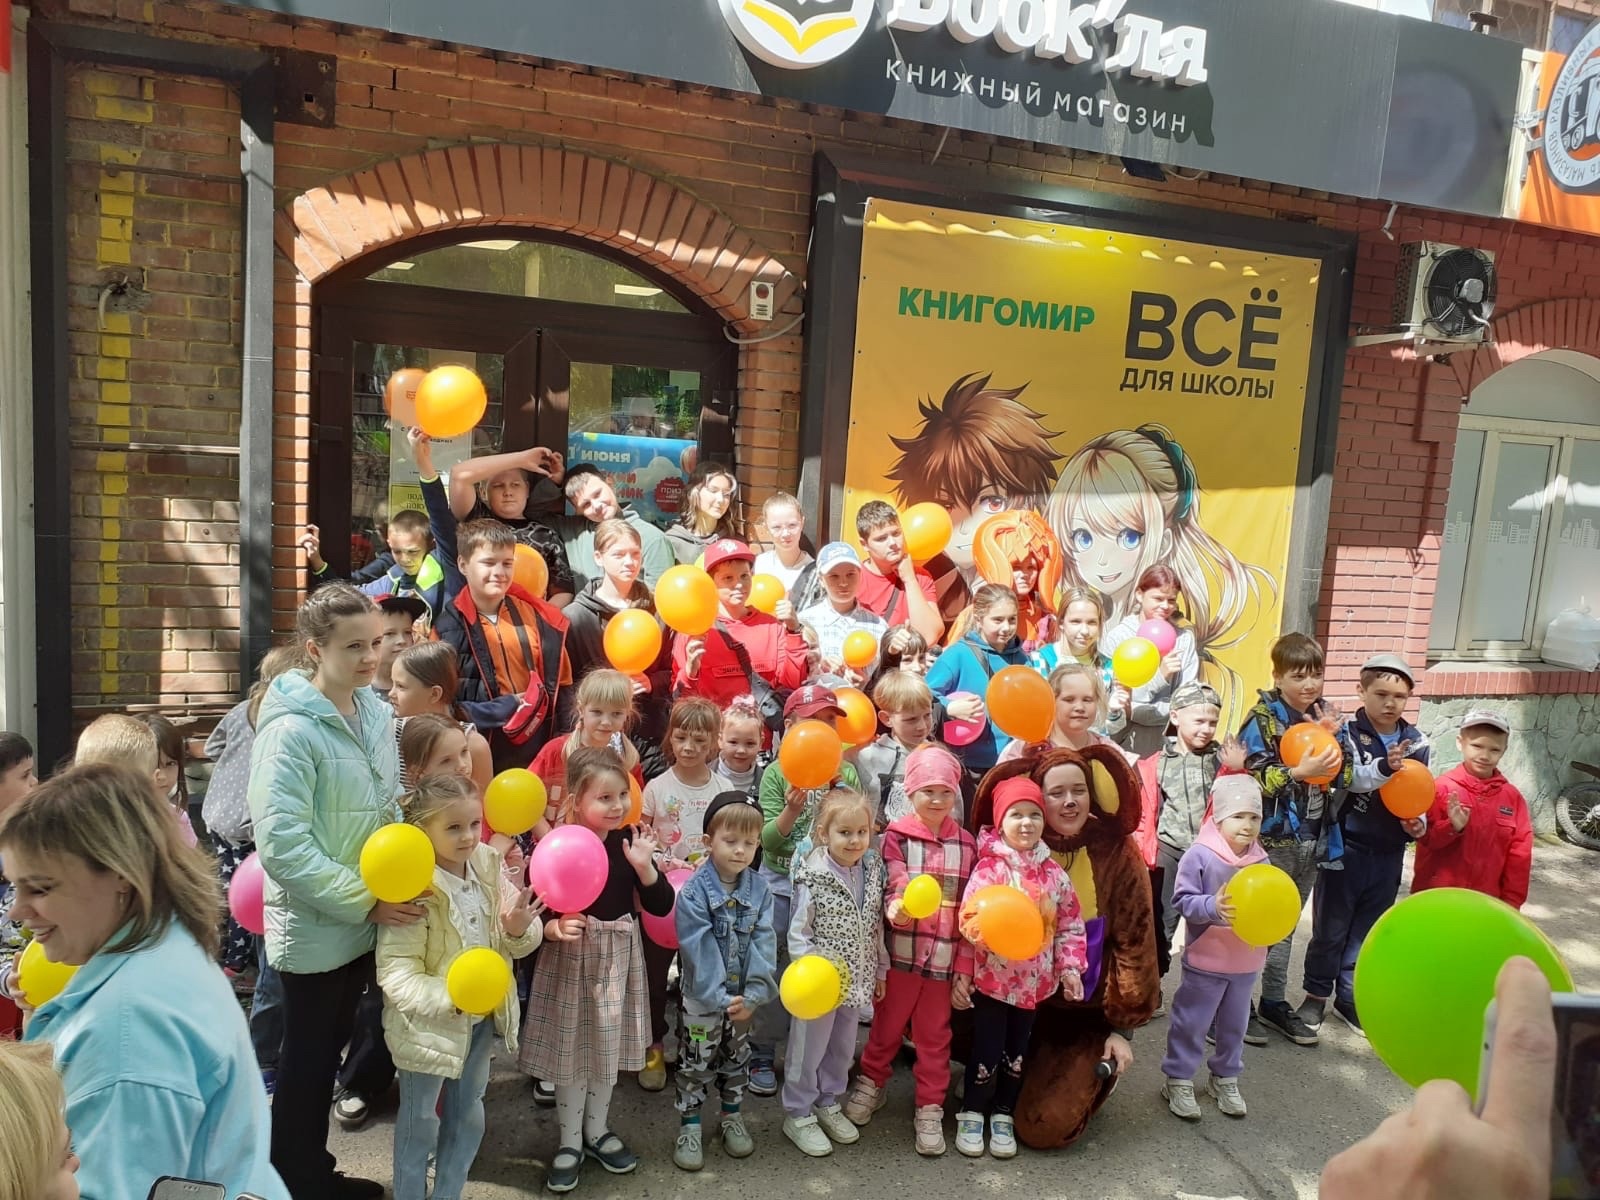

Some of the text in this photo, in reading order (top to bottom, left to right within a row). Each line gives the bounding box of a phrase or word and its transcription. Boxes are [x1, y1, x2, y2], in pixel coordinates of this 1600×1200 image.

[885, 59, 1186, 134] книжный магазин
[897, 286, 1096, 334] КНИГОМИР
[1123, 287, 1282, 372] ВСЁ
[1119, 367, 1275, 399] ДЛЯ ШКОЛЫ
